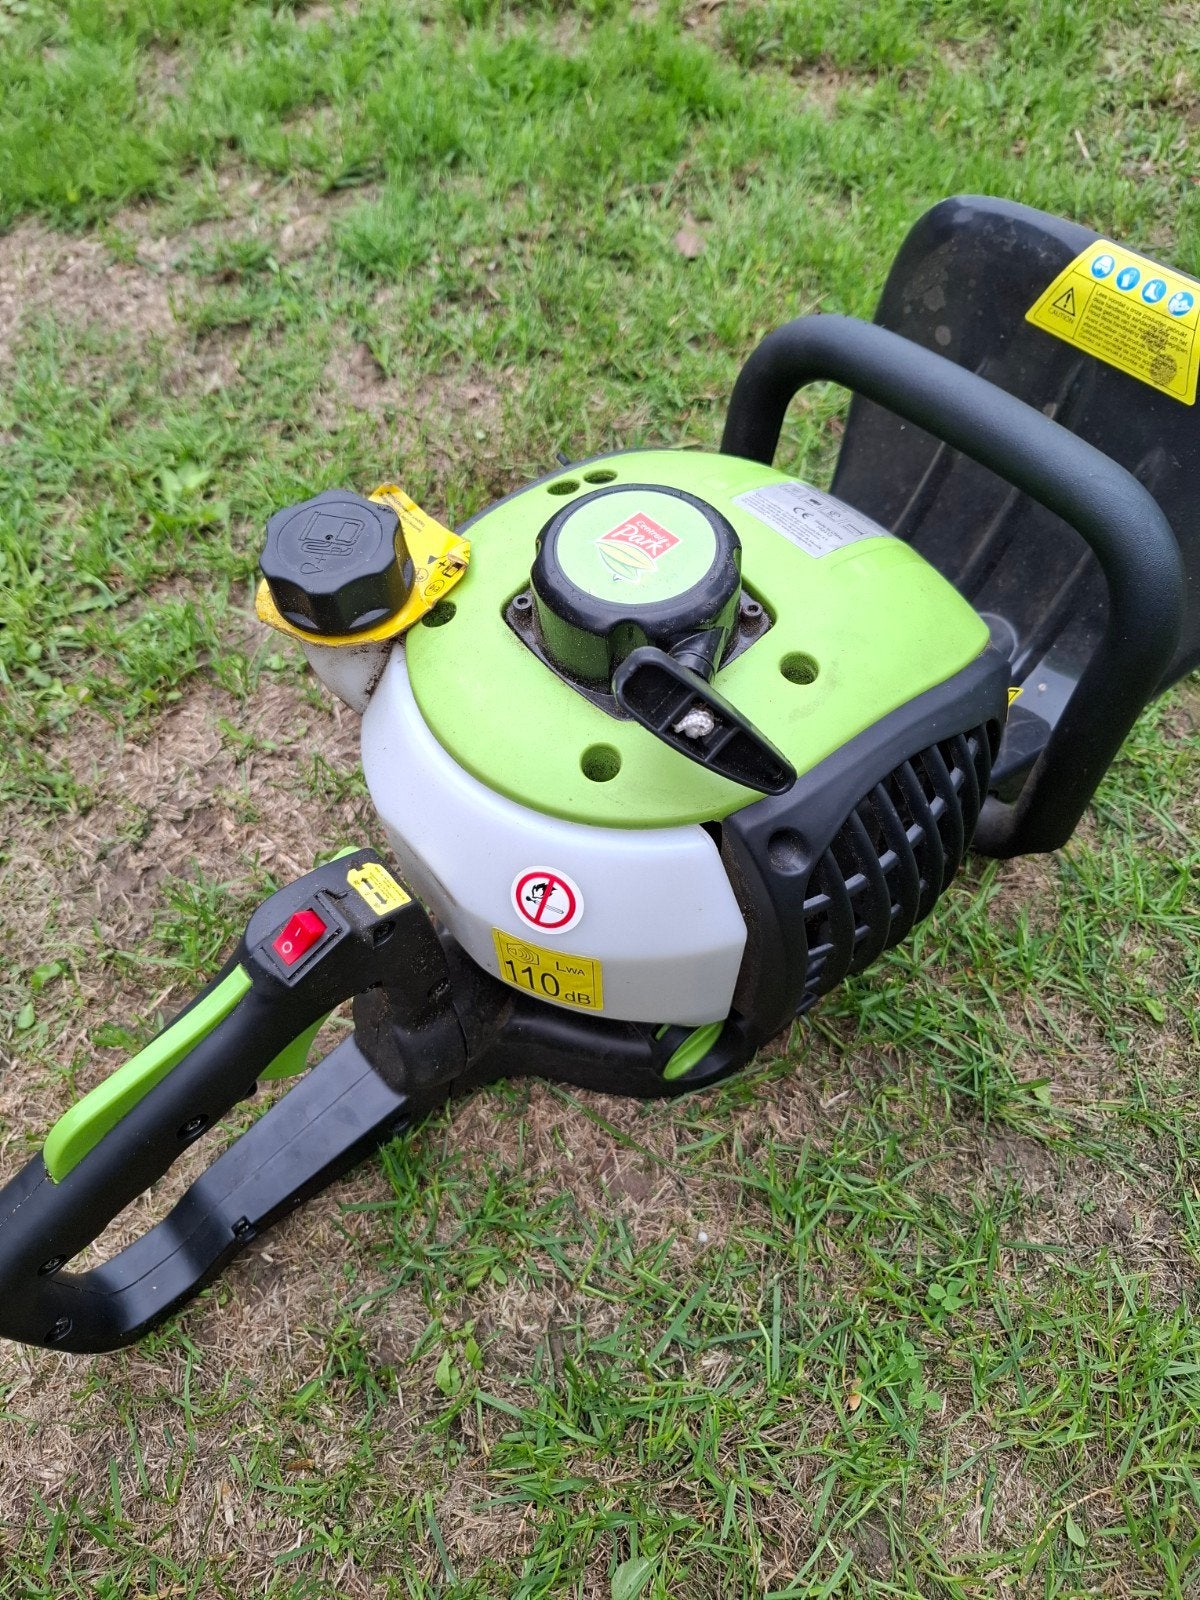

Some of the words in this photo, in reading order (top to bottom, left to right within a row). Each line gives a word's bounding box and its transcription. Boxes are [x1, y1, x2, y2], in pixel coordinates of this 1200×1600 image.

[1167, 325, 1186, 338] gebruikt
[610, 524, 663, 557] Park
[505, 960, 560, 997] 110
[564, 991, 591, 1004] dB
